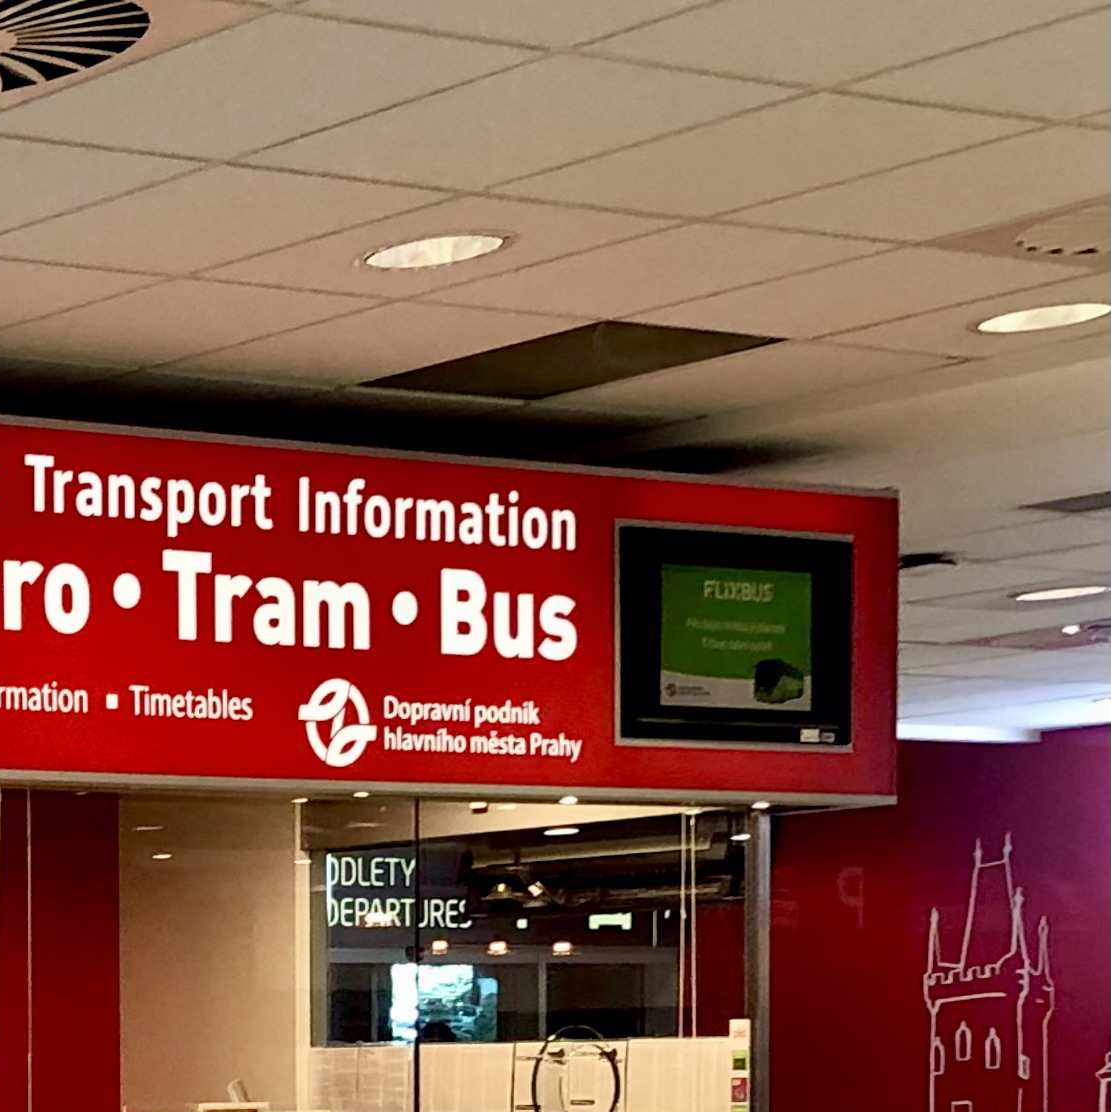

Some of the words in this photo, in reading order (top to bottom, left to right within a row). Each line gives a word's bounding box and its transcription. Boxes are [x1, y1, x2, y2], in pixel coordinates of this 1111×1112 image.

[24, 453, 274, 538] Transport
[298, 476, 576, 551] Information
[162, 548, 371, 651] Tram
[440, 567, 578, 661] Bus
[128, 684, 254, 721] Timetables
[383, 695, 472, 726] Dopravní
[473, 699, 541, 729] podnik
[383, 725, 467, 754] hlavního
[469, 730, 527, 756] města
[529, 732, 583, 763] Prahy
